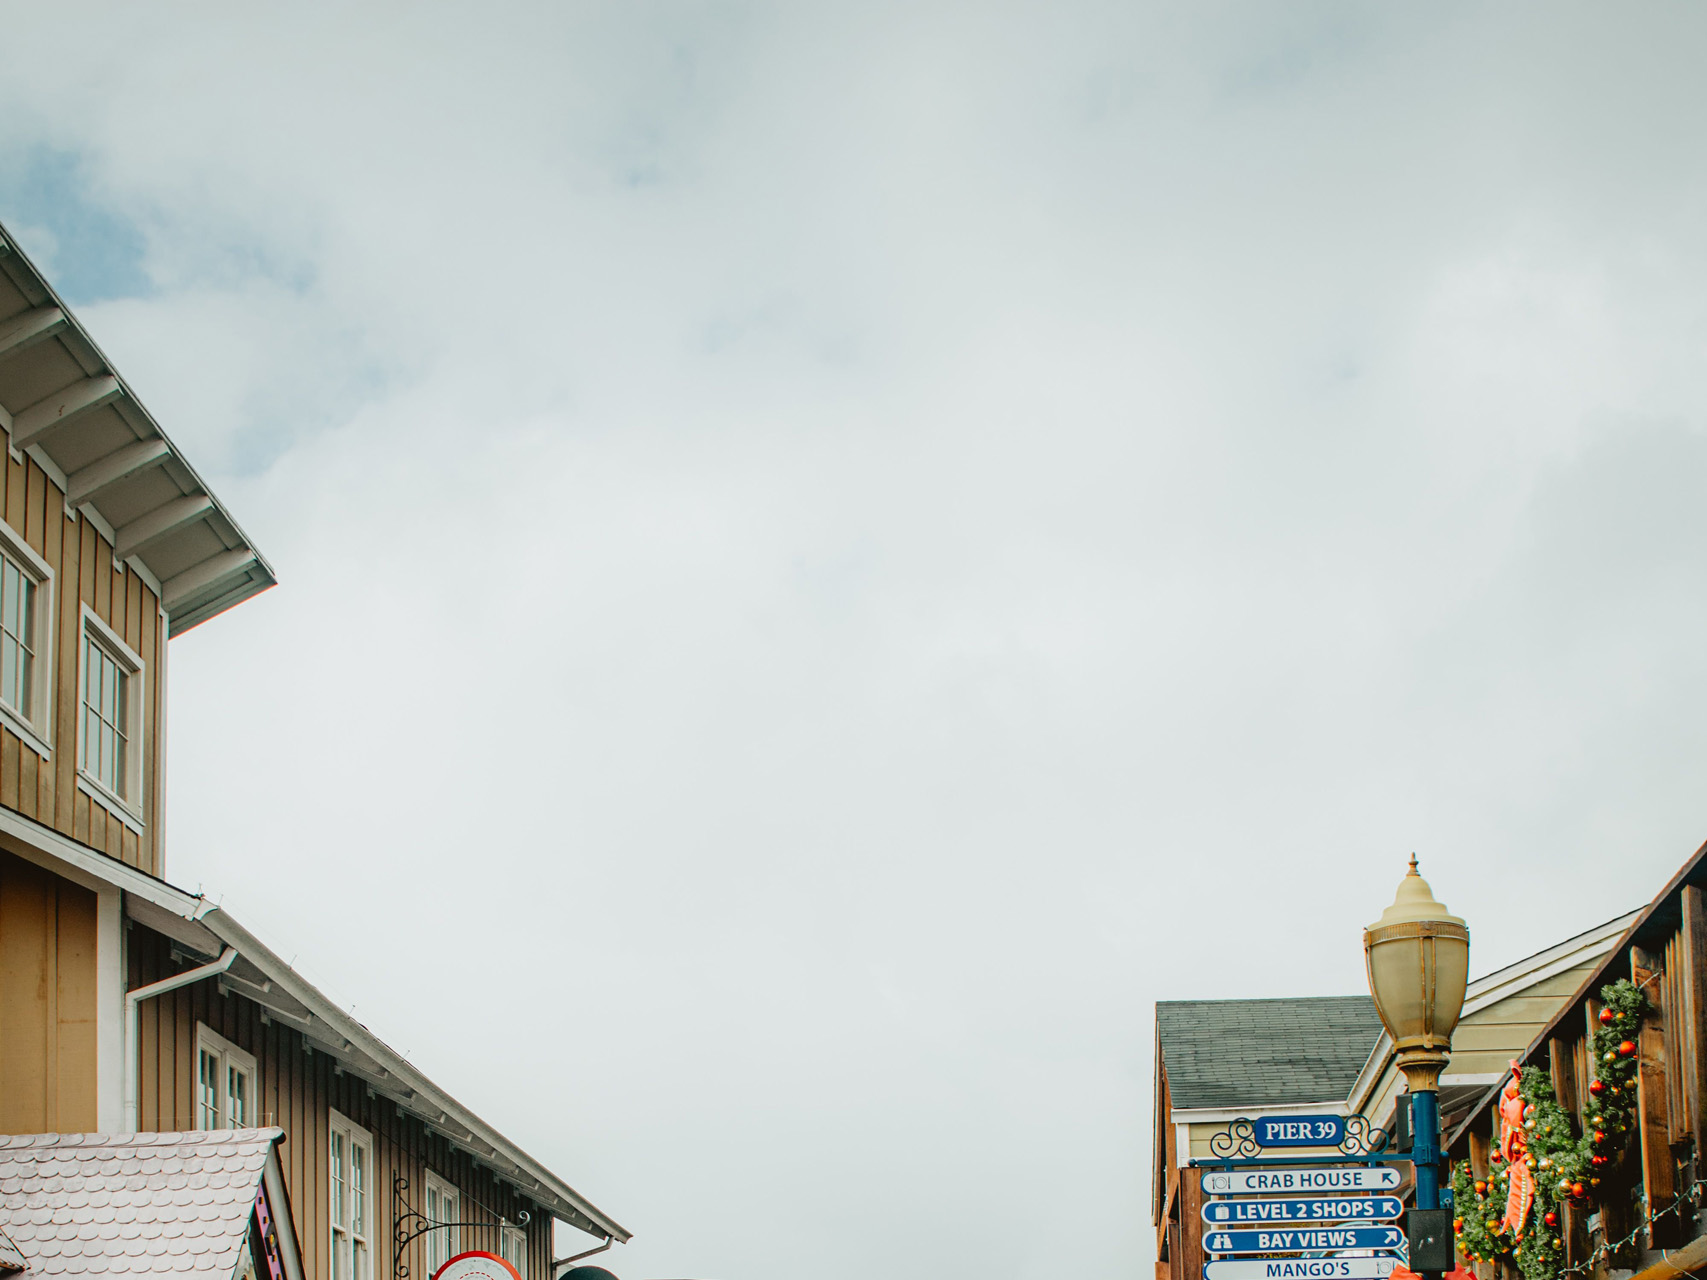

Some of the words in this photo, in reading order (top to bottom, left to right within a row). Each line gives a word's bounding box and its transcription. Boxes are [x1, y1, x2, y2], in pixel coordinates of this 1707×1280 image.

[1265, 1122, 1313, 1140] PIER
[1314, 1121, 1337, 1139] 39
[1246, 1174, 1294, 1189] CRAB
[1300, 1172, 1363, 1187] HOUSE
[1236, 1204, 1291, 1220] LEVEL
[1296, 1203, 1307, 1218] 2
[1312, 1201, 1374, 1217] SHOPS
[1258, 1233, 1294, 1249] BAY
[1297, 1231, 1356, 1247] VIEWS
[1266, 1262, 1350, 1278] MANGO'S
